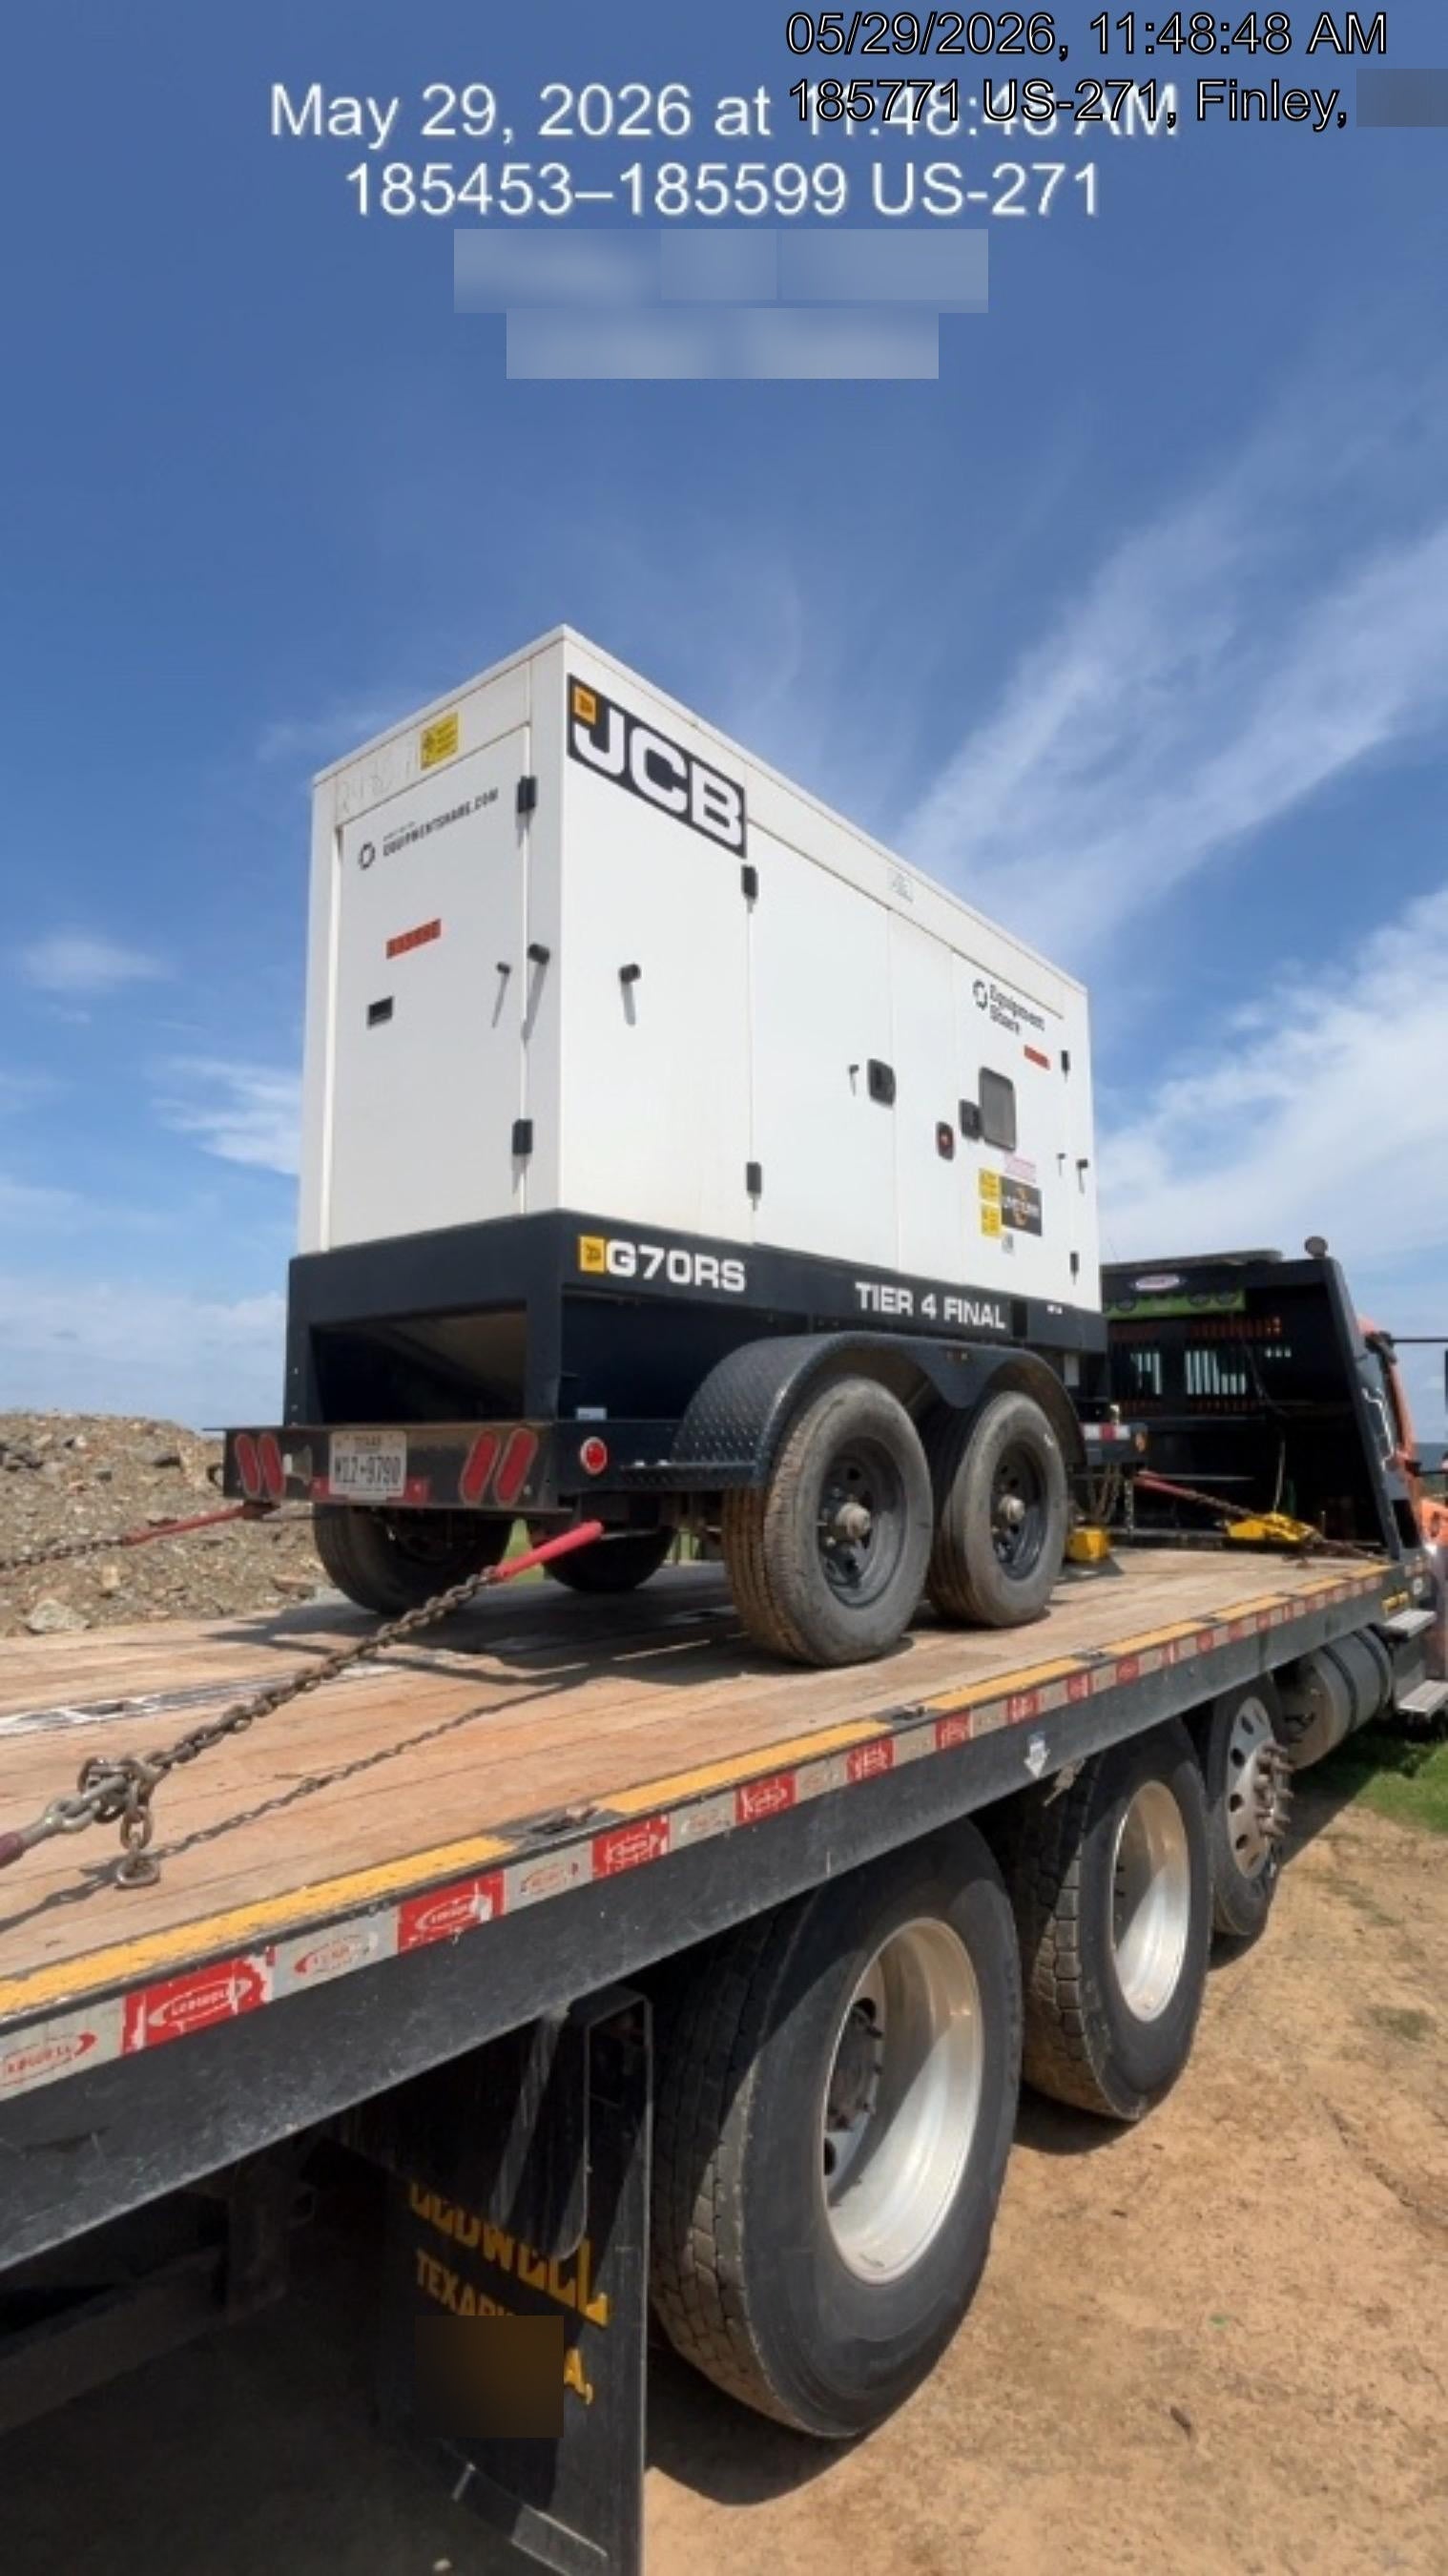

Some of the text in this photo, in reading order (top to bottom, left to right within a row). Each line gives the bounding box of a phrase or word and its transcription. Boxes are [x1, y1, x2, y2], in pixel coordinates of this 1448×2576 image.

[573, 706, 743, 848] JCB
[605, 1239, 747, 1294] G70RS
[854, 1280, 1006, 1330] TIER 4 FINAL
